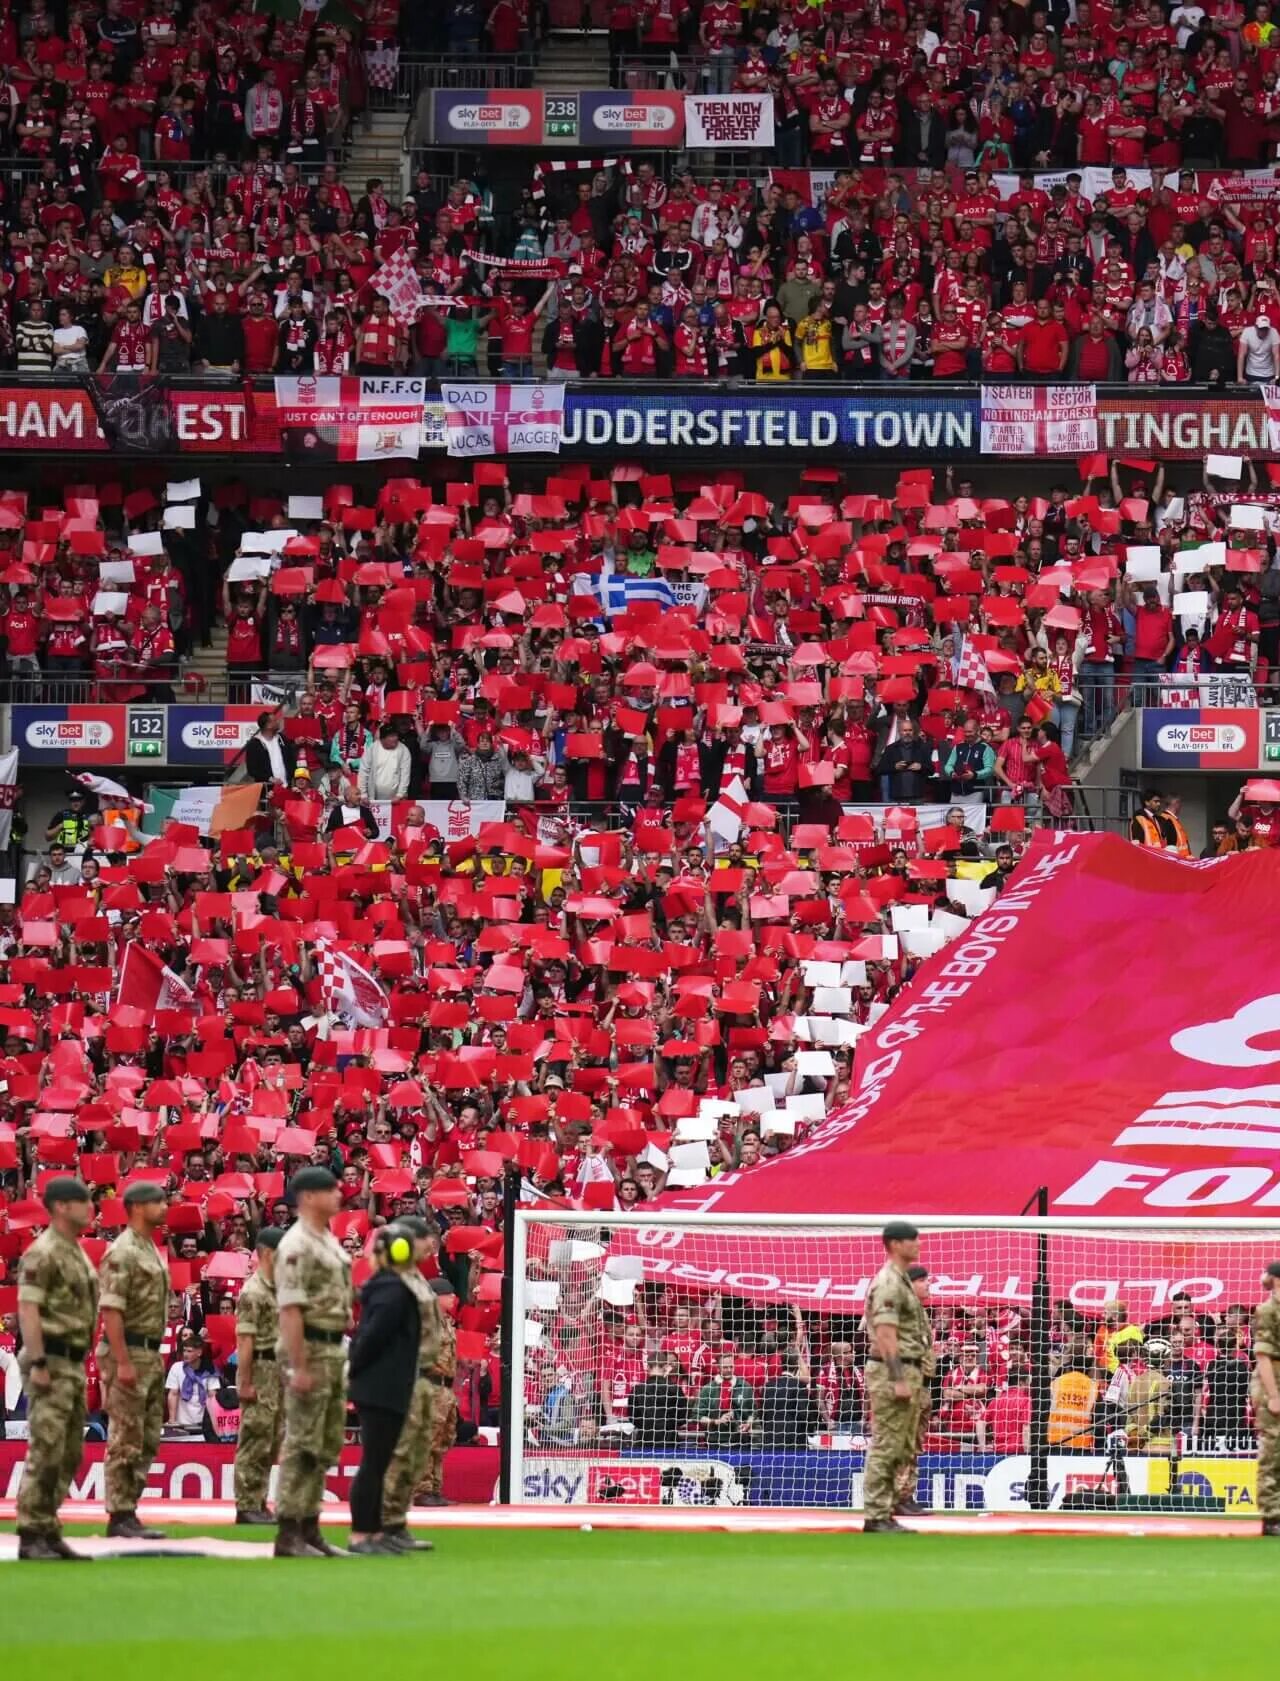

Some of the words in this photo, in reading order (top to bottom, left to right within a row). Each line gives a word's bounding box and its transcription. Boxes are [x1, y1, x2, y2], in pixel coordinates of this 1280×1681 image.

[458, 108, 478, 120] sky
[480, 109, 500, 119] bet
[546, 101, 577, 116] 238
[602, 108, 622, 121] sky
[624, 109, 645, 119] bet
[695, 102, 729, 115] THEN
[732, 102, 762, 115] NOW
[608, 121, 641, 129] PLAY-OFFS
[701, 115, 760, 129] FOREVER
[706, 127, 757, 141] FOREST
[448, 392, 488, 405] DAD
[992, 387, 1033, 401] SEATER
[1051, 392, 1092, 406] SECTOR
[310, 411, 344, 423] CAN'T
[347, 411, 369, 422] GET
[371, 410, 418, 421] ENOUGH
[465, 410, 539, 426] NFFC
[984, 408, 1053, 421] NOTTINGHAM
[1055, 406, 1096, 420] FOREST
[562, 408, 838, 446] UDDERSFIELD
[847, 410, 972, 447] TOWN
[452, 436, 491, 451] LUCAS
[511, 430, 559, 446] JAGGER
[672, 583, 691, 591] THE
[668, 592, 697, 601] EGGY
[862, 594, 897, 604] OTTINGHAM
[35, 723, 57, 738] sky
[60, 724, 82, 737] bet
[131, 718, 162, 734] 132
[191, 723, 213, 738] sky
[215, 724, 239, 737] bet
[1167, 727, 1189, 742] sky
[1191, 728, 1215, 740] bet
[41, 738, 78, 747] PLAY-OFFS
[197, 738, 233, 747] PLAY-OFFS
[1172, 742, 1209, 751] PLAY-OFFS
[1221, 742, 1235, 751] EFL
[876, 1017, 926, 1049] OF
[904, 981, 972, 1024] THE
[939, 914, 1019, 979] BOYS
[638, 1256, 1033, 1302] TRFFORD
[1068, 1276, 1225, 1306] OLD
[522, 1468, 583, 1505] sky
